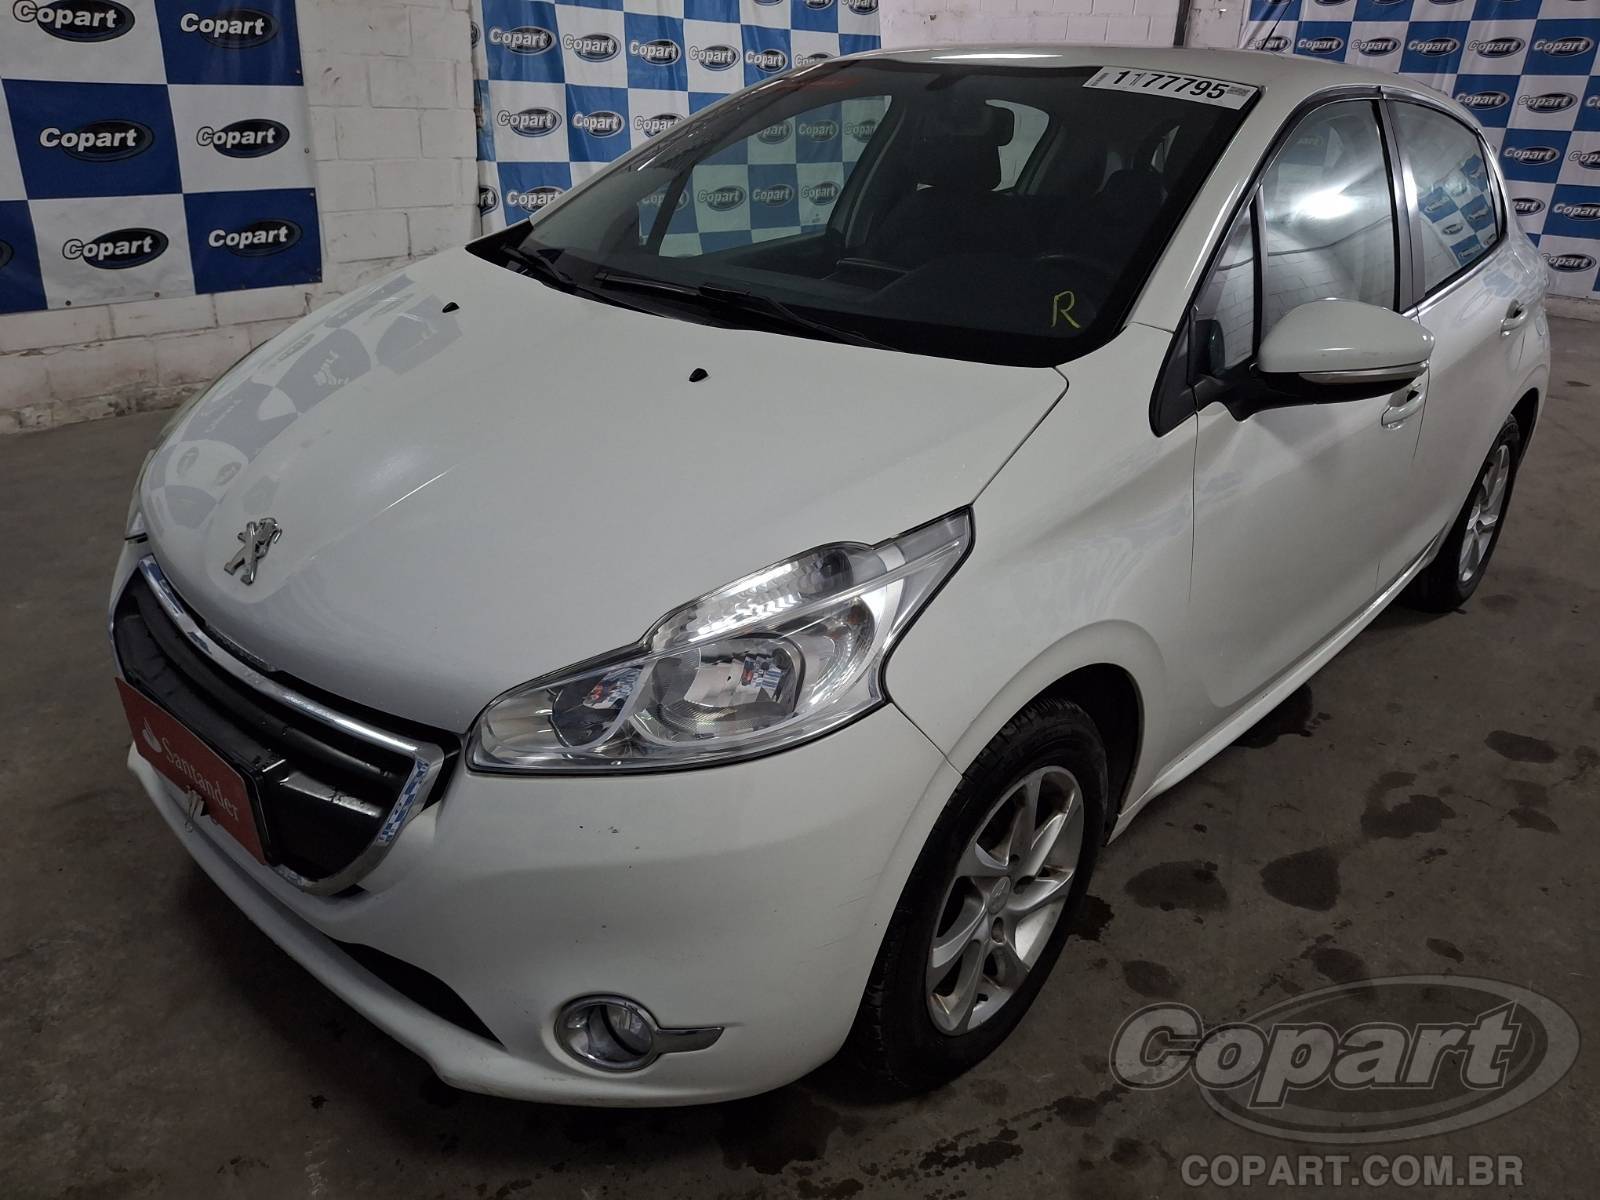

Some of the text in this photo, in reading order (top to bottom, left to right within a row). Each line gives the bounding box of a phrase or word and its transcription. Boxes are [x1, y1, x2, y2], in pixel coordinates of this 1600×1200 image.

[13, 0, 117, 28] Copart
[180, 12, 265, 36] Copart
[488, 28, 549, 49] Copart
[562, 33, 615, 54] Copart
[1298, 38, 1338, 51] Copart
[1352, 39, 1394, 52] Copart
[1408, 39, 1453, 52] Copart
[1469, 39, 1517, 52] Copart
[1534, 38, 1586, 52] Copart
[629, 41, 677, 58] Copart
[689, 45, 733, 64] Copart
[744, 50, 782, 69] Copart
[1456, 92, 1502, 105] Copart
[1518, 95, 1568, 108] Copart
[497, 109, 553, 130] Copart
[572, 112, 619, 132] Copart
[39, 127, 137, 152] Copart
[196, 126, 276, 149] Copart
[799, 123, 834, 137] Copart
[1504, 147, 1554, 160] Copart
[698, 189, 740, 205] Copart
[753, 187, 790, 203] Copart
[801, 184, 836, 200] Copart
[208, 225, 289, 250] Copart
[62, 235, 153, 261] Copart
[1050, 290, 1081, 329] R
[161, 737, 240, 822] Santander
